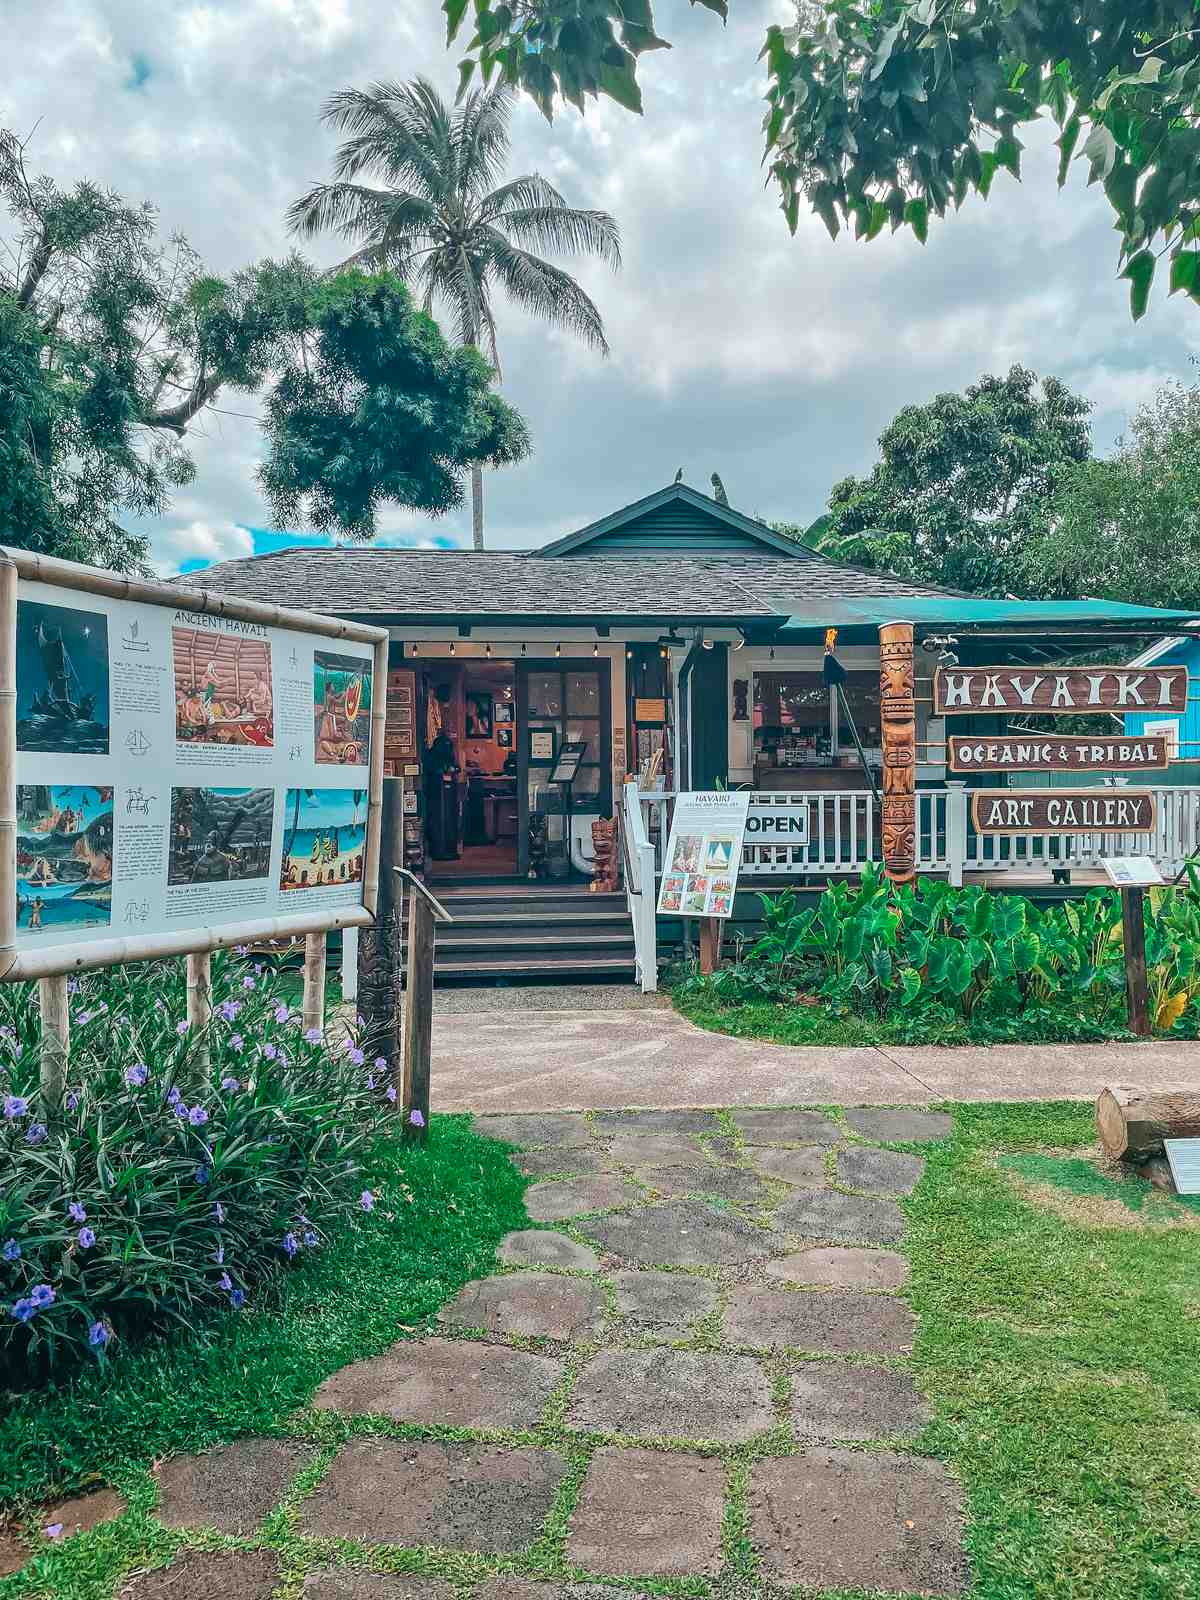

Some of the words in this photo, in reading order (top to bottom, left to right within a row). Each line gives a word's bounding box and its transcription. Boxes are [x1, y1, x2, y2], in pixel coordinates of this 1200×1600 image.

[174, 611, 224, 628] ANCIENT
[225, 620, 267, 637] HAWAII
[959, 744, 1052, 763] OCEANIC
[1058, 745, 1069, 761] &
[1075, 744, 1159, 763] TRIBAL
[985, 799, 1034, 826] ART
[1047, 799, 1143, 826] GALLERY
[745, 816, 804, 833] OPEN
